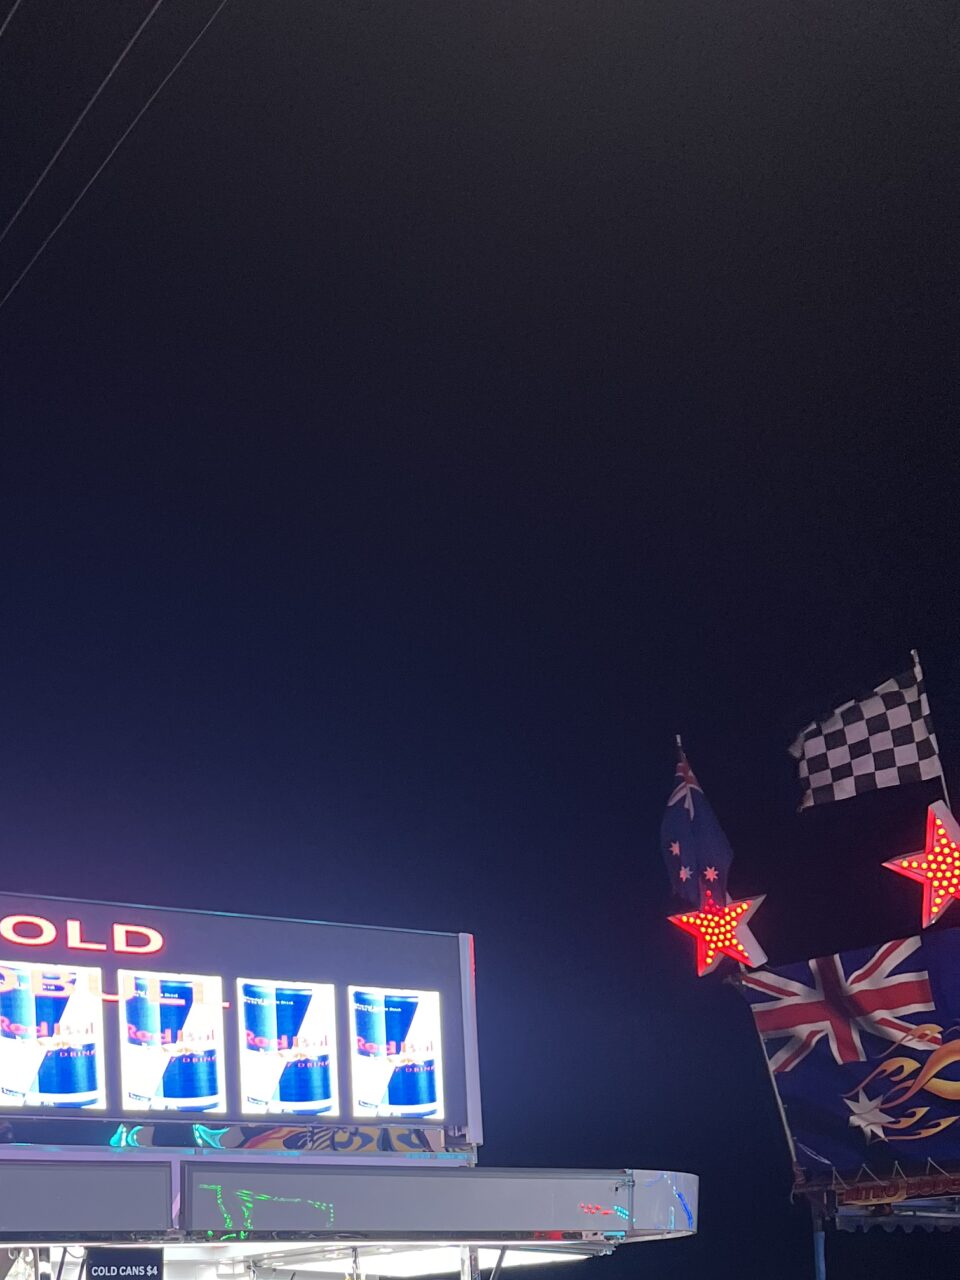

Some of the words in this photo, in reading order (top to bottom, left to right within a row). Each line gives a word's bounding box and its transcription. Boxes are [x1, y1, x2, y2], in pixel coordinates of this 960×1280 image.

[91, 1266, 117, 1276] COLD
[119, 1265, 145, 1275] CANS
[146, 1264, 158, 1277] $4
